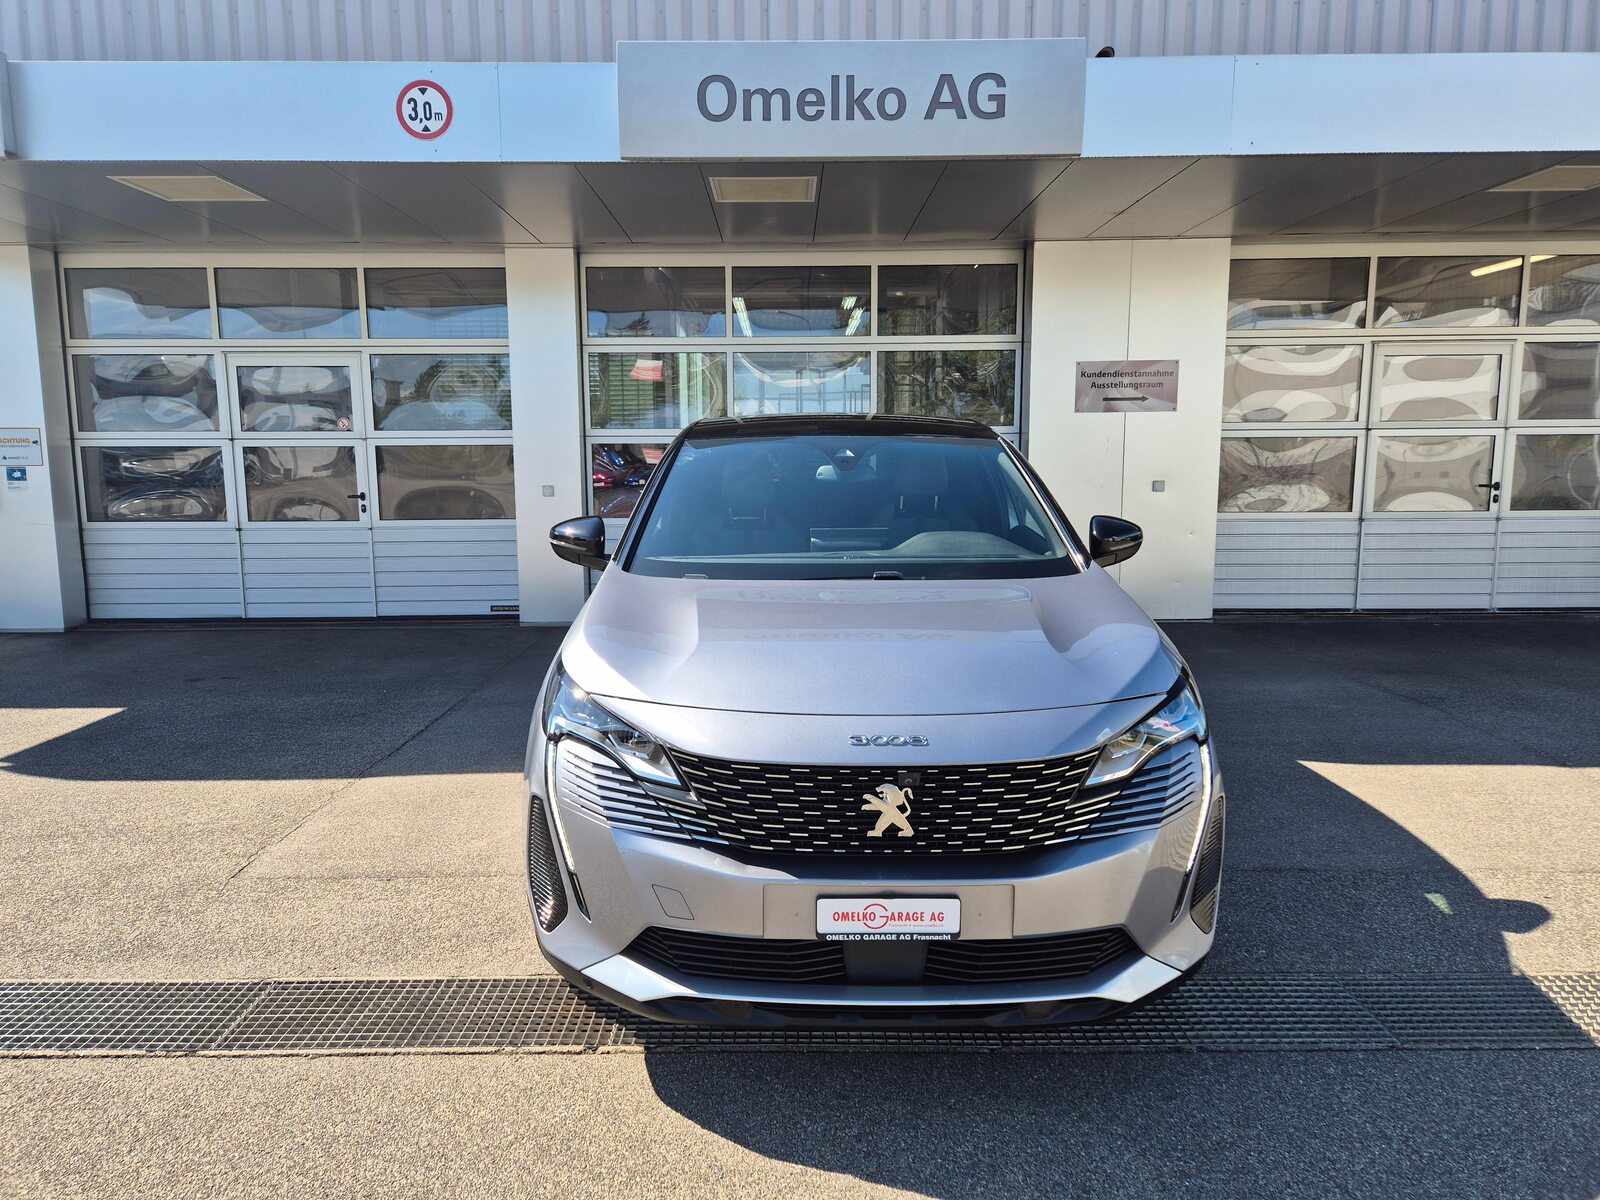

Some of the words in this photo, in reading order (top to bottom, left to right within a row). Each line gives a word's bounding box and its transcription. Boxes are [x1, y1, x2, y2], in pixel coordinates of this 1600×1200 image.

[696, 73, 907, 122] Omelko
[923, 71, 1007, 120] AG
[1080, 369, 1174, 378] Kundendienstannahme
[1090, 381, 1164, 390] Ausstellungsraum
[848, 734, 929, 746] 3008
[832, 911, 876, 922] OMELKO
[929, 911, 945, 922] AG
